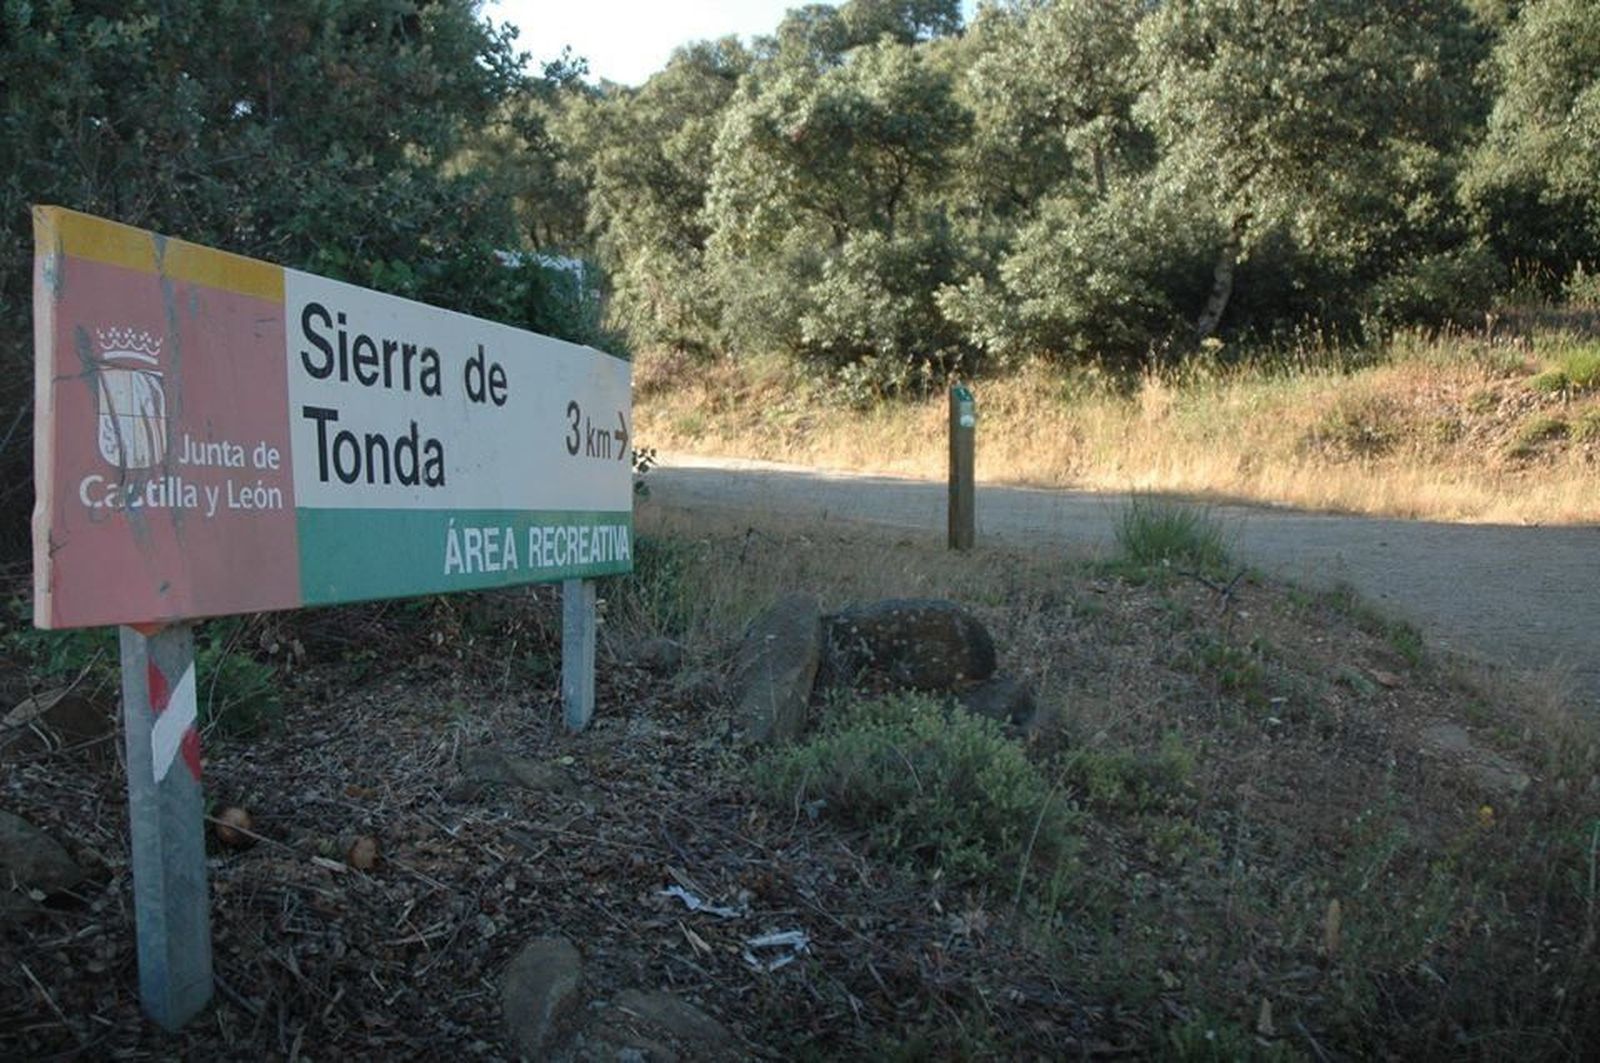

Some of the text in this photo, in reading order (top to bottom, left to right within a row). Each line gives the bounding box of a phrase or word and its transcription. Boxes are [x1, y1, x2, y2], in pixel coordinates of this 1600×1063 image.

[301, 302, 508, 407] Sierra de
[179, 433, 281, 470] Junta de
[302, 405, 445, 488] Tonda
[566, 400, 611, 459] 3 km
[205, 485, 219, 517] y
[227, 479, 283, 510] León
[444, 517, 630, 575] ÁREA RECREATIVA
